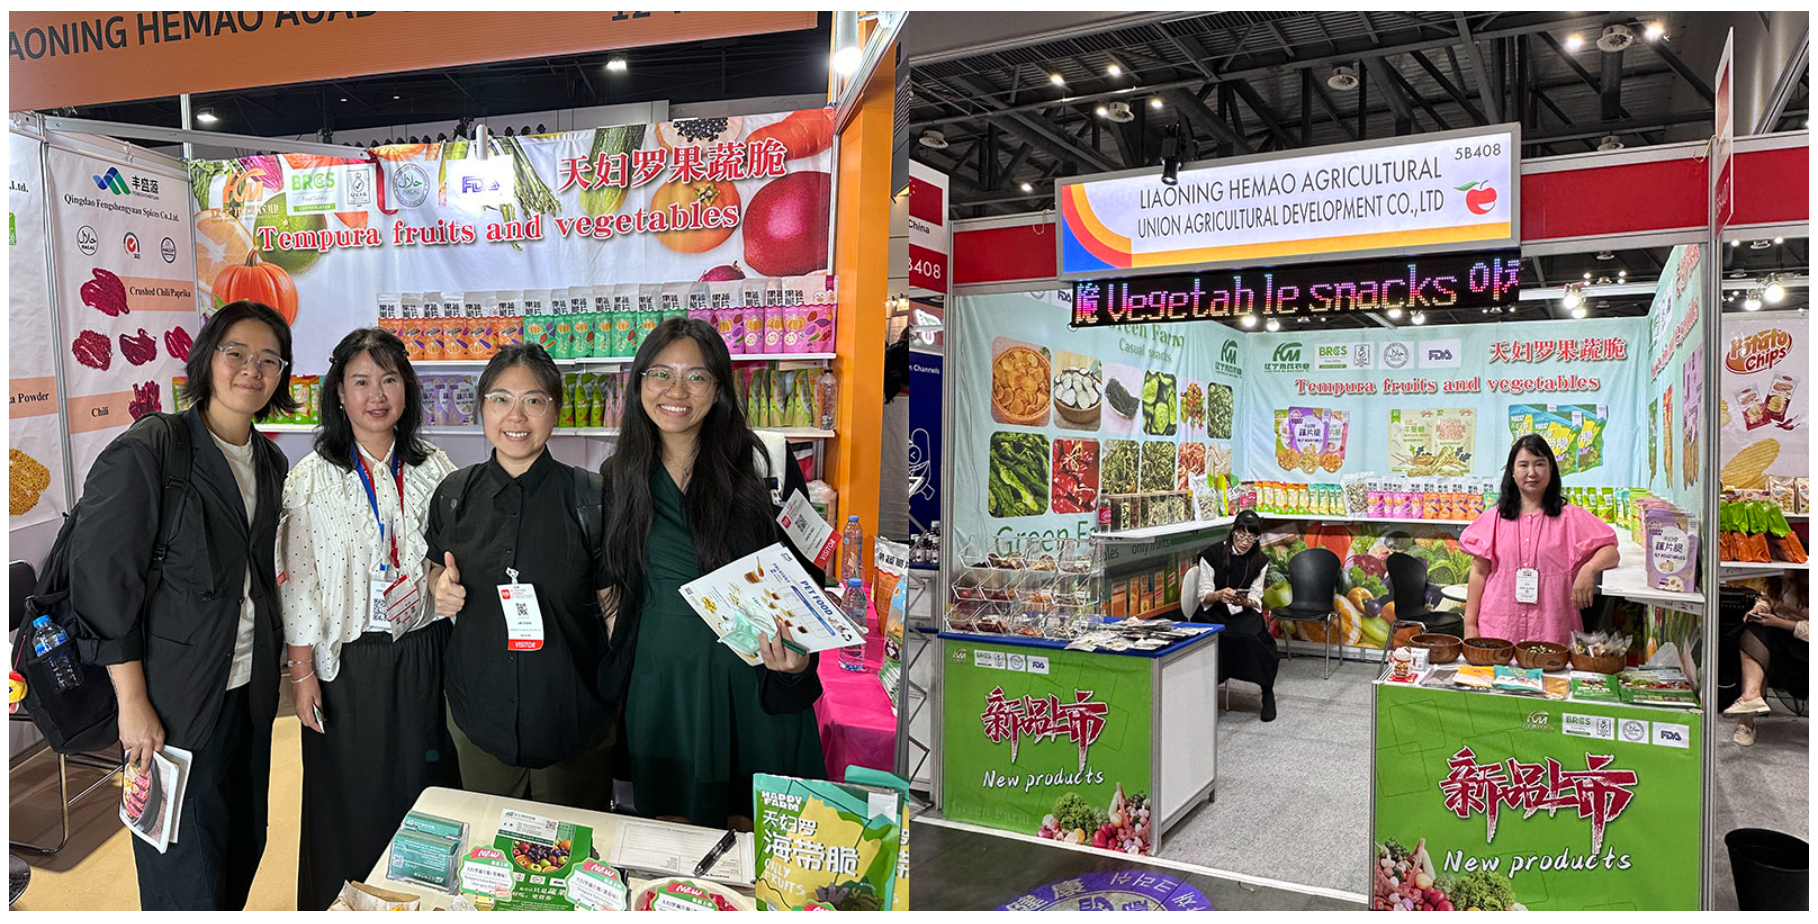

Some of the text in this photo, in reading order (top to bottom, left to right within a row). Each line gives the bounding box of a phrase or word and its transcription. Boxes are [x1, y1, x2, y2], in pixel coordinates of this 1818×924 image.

[138, 11, 263, 46] HEMAO
[1454, 142, 1502, 161] 5B408
[557, 138, 788, 194] 天妇罗果蔬脆
[1140, 157, 1442, 210] LIAONING HEMAO AGRICULTURAL
[64, 192, 96, 207] Qingdao
[257, 202, 740, 253] Tempura fruits and vegetables
[909, 218, 930, 235] China
[1138, 215, 1181, 239] UNION
[1185, 205, 1279, 234] AGRICULTURAL
[1283, 196, 1381, 226] DEVELOPMENT
[130, 285, 155, 298] Crushed
[1309, 264, 1458, 312] snacks
[1119, 337, 1145, 356] Casual
[1428, 348, 1453, 361] FDA
[1488, 336, 1628, 365] 天妇罗果蔬脆
[1730, 328, 1788, 358] Potato
[1745, 347, 1786, 371] Chips
[18, 391, 50, 404] Powder
[1294, 373, 1600, 398] Tempura fruits and vegetables
[91, 405, 110, 418] Chili
[820, 537, 837, 561] VISITOR
[800, 580, 833, 616] PET FOOD
[980, 686, 1108, 772] 新品上市
[1660, 730, 1682, 741] FDA
[982, 766, 1105, 793] New products
[1439, 745, 1638, 856] 新品上市
[763, 810, 818, 837] 天妇罗
[478, 849, 500, 858] NEW
[764, 829, 861, 878] 海带脆
[1443, 847, 1632, 879] New products
[590, 863, 615, 878] NEW
[764, 858, 792, 877] ONLY
[675, 884, 703, 897] NEW
[764, 868, 806, 896] FRUITS
